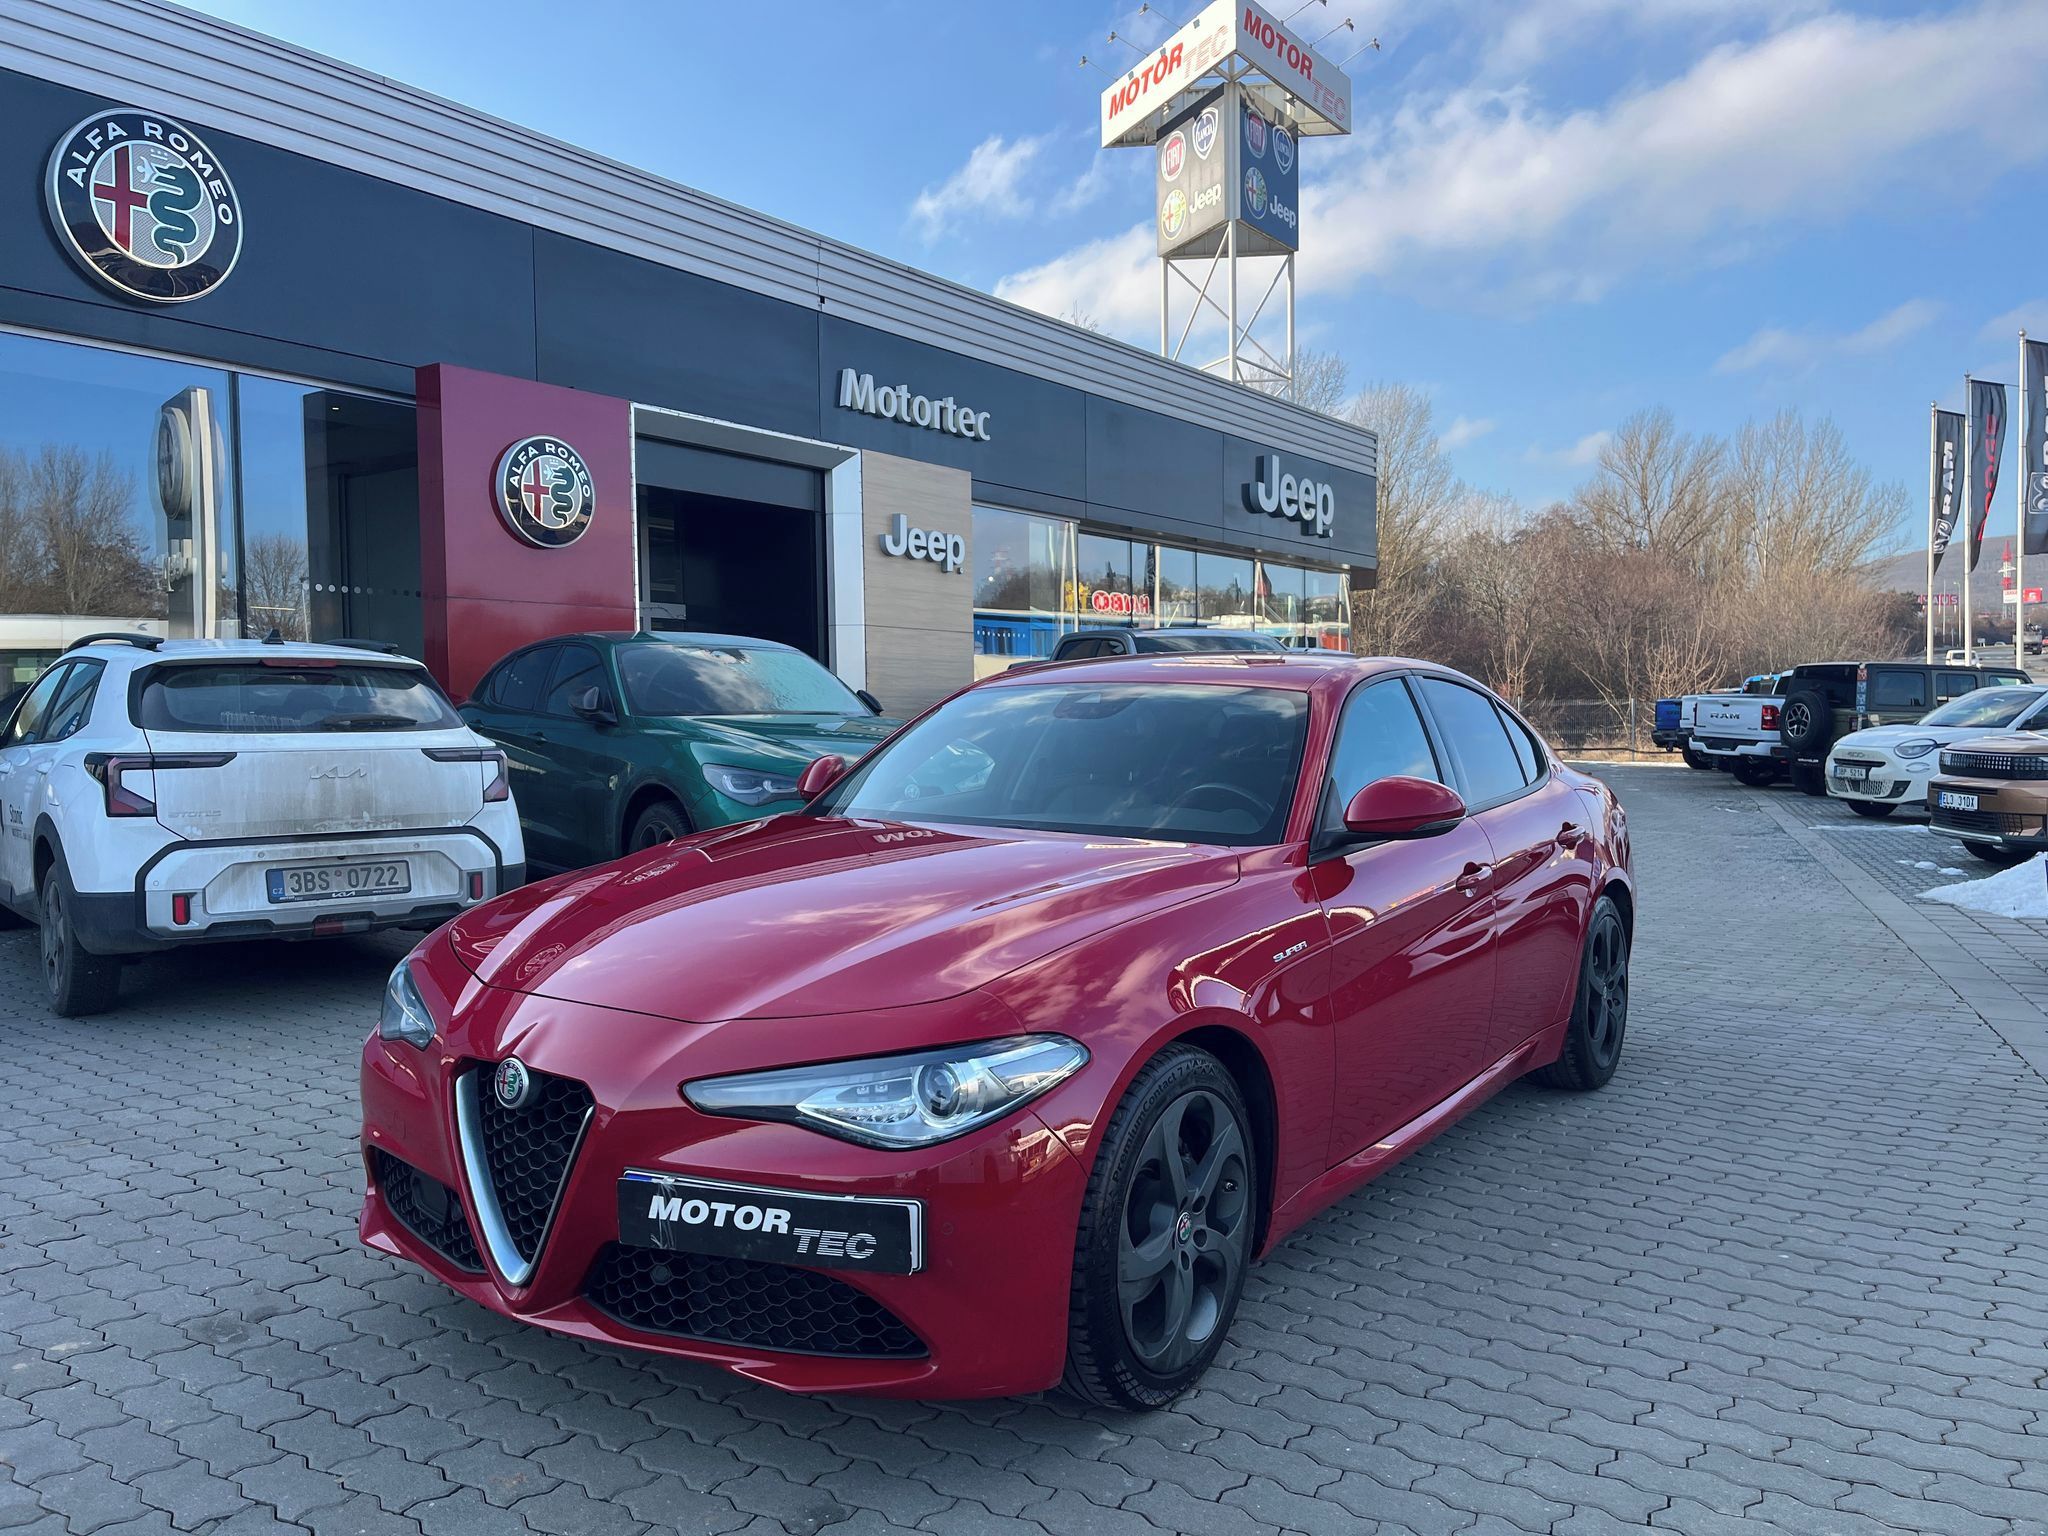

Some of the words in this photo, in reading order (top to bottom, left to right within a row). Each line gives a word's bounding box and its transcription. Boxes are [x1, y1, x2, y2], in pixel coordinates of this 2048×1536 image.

[1108, 41, 1184, 121] MOTOR
[1184, 24, 1229, 80] TEC
[1243, 7, 1313, 81] MOTOR
[1312, 78, 1346, 122] TEC
[66, 121, 129, 189] ALFA
[142, 120, 233, 225] ROMEO
[1166, 142, 1182, 173] FIAT
[1189, 183, 1222, 214] Jeep
[1269, 194, 1297, 229] Jeep
[839, 367, 991, 442] Motortec
[509, 446, 539, 488] ALFA
[544, 442, 591, 498] ROMEO
[1250, 454, 1335, 537] Jeep
[1942, 440, 1955, 516] RAM
[880, 512, 966, 573] Jeep
[1709, 712, 1741, 720] RAM
[272, 886, 284, 895] CZ
[288, 870, 331, 893] 3BS
[346, 865, 400, 889] 0722
[1272, 940, 1308, 963] SUPER
[1111, 1071, 1178, 1183] PremiumContact
[647, 1195, 792, 1235] MOTOR
[792, 1227, 878, 1260] TEC
